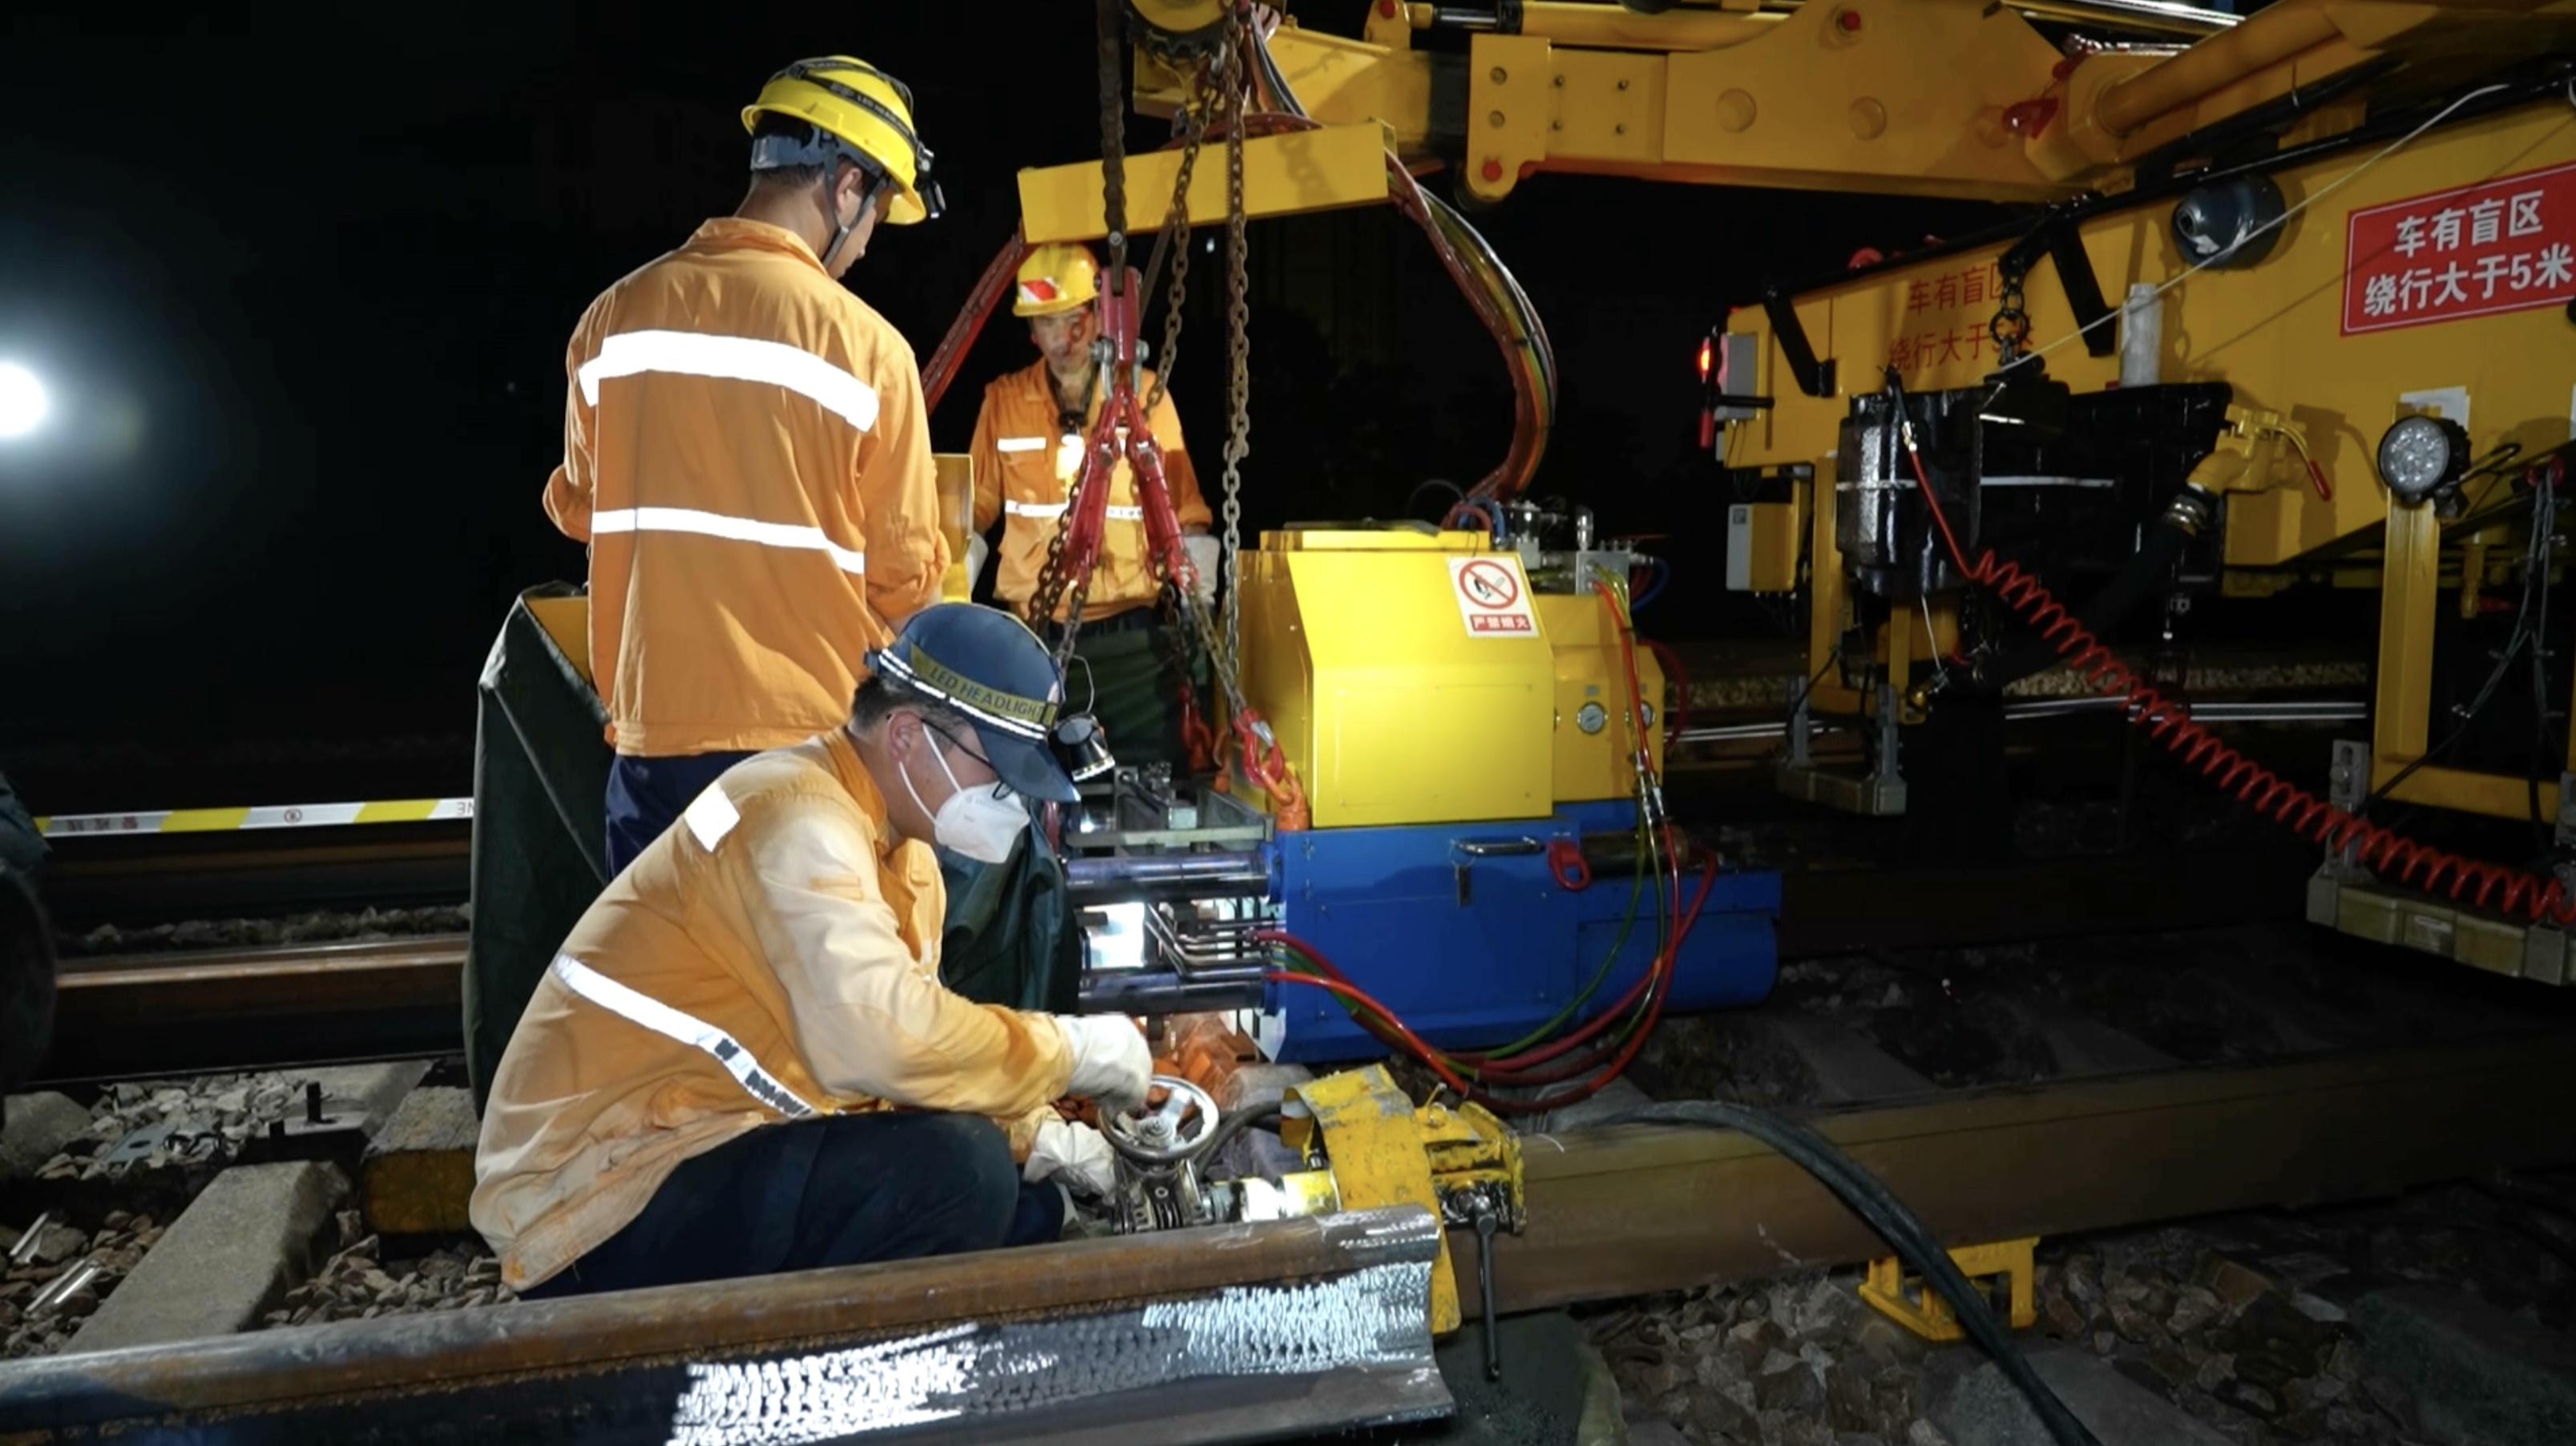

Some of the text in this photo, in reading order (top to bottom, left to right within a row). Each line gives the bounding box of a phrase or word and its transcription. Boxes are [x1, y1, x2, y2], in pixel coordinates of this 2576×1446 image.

[2393, 189, 2544, 259] 车有盲区
[2364, 242, 2574, 317] 绕行大于5米
[929, 666, 959, 689] LED
